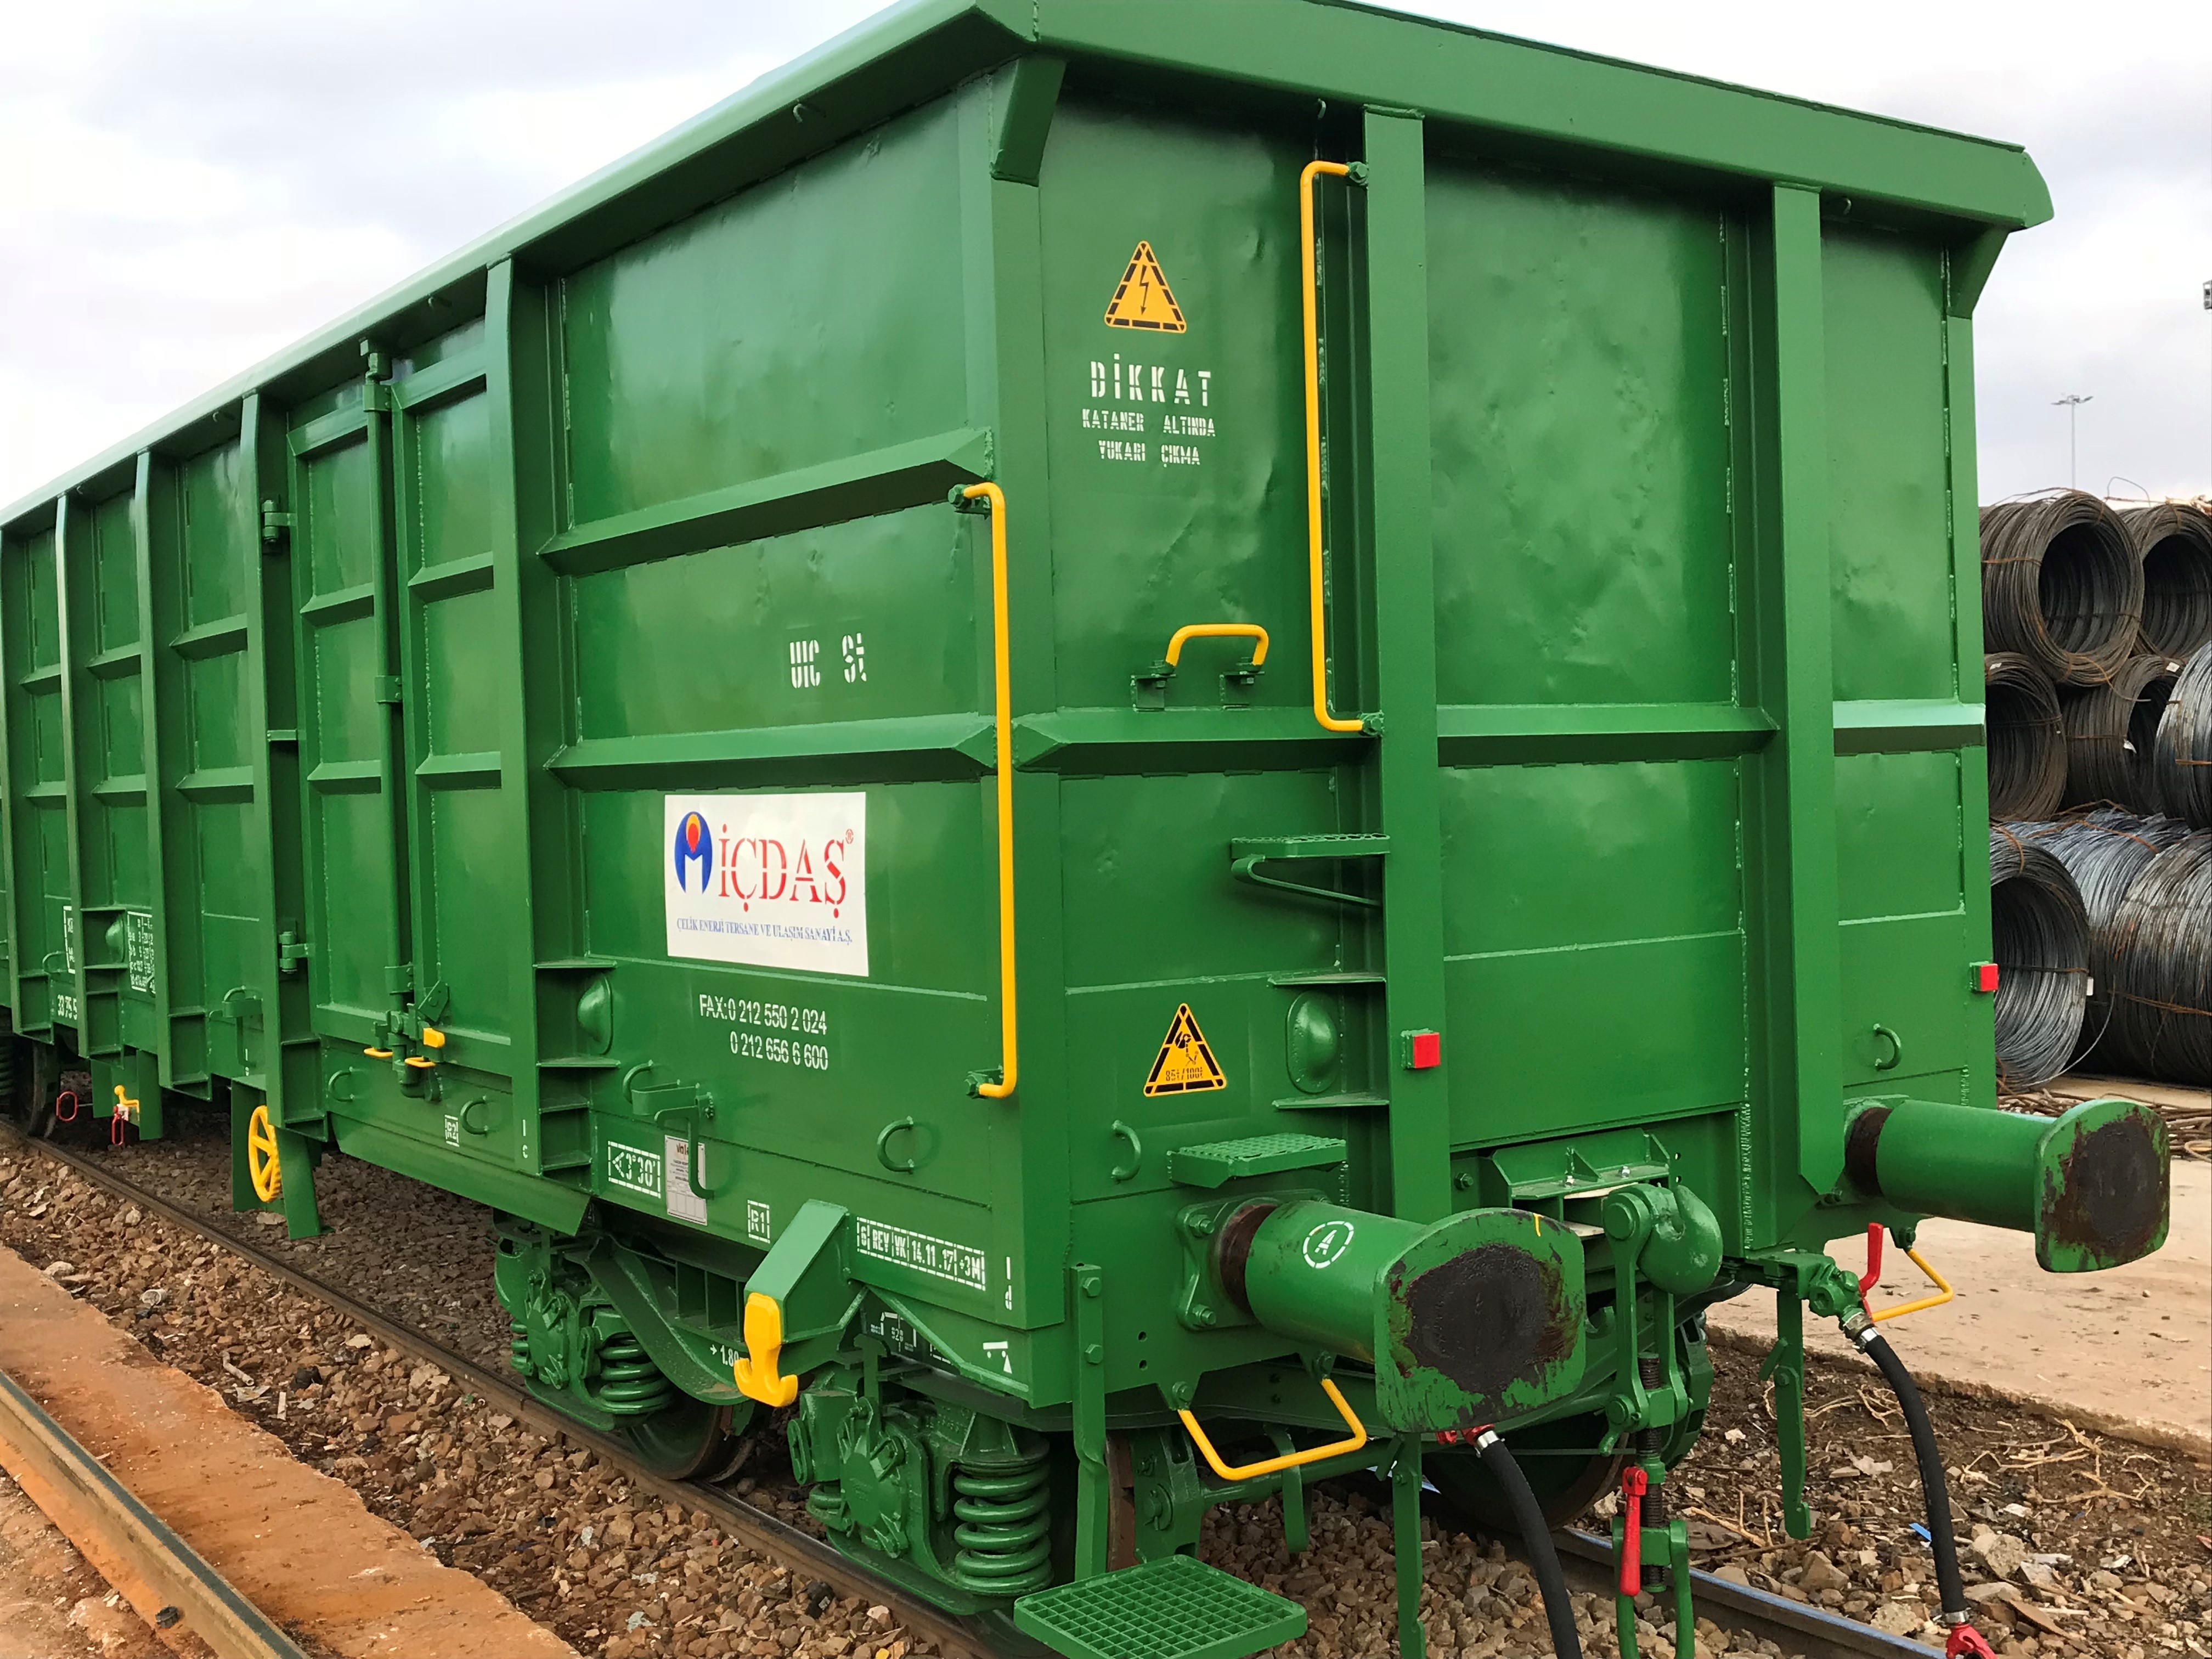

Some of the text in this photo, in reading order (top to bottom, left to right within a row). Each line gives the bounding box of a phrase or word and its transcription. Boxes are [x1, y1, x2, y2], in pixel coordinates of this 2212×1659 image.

[1091, 354, 1210, 406] DİKKAT
[1082, 409, 1215, 436] KATANER ALTINDA
[1099, 441, 1200, 467] YUKARI ÇIKMA
[677, 916, 698, 932] ÇELİK
[725, 922, 759, 935] TERSANE
[760, 924, 771, 936] VE
[739, 1000, 760, 1024] 212
[765, 1003, 787, 1029] 550
[791, 1007, 799, 1030] 2
[803, 1009, 827, 1035] 024
[730, 1031, 828, 1070] 0 212 656 6 600
[872, 1229, 889, 1252] REV
[1314, 1229, 1338, 1255] A
